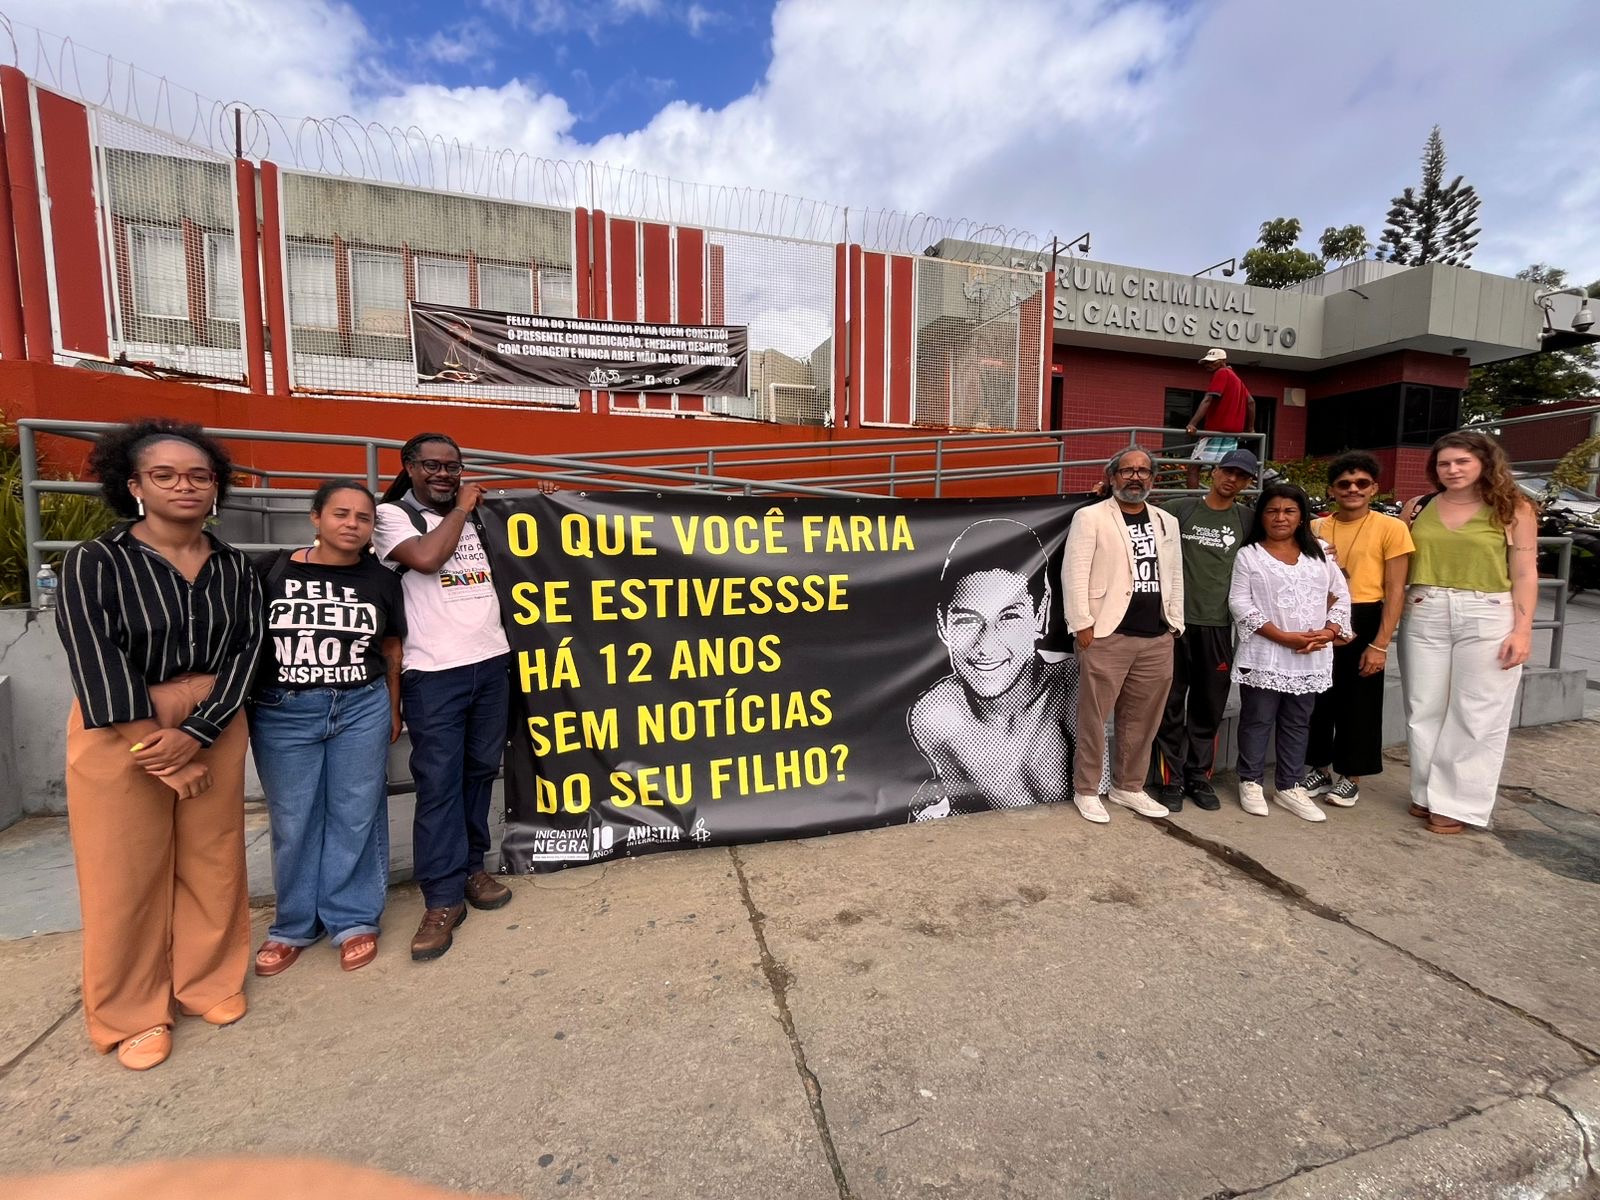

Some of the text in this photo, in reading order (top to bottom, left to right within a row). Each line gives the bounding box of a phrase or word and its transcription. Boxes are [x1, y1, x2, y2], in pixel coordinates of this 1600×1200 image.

[1121, 274, 1256, 315] CRIMINAL
[506, 315, 728, 340] FELIZ DIA DO TRABALHADOR PARA QUEM CONSTRÓI
[1083, 300, 1198, 337] CARLOS
[1209, 318, 1297, 348] SOUTO
[497, 342, 738, 367] COM CORAGEM E NUNCA ABRE MÃO DA SUA DIGNIDADE.
[507, 329, 515, 340] O
[516, 329, 564, 343] PRESENTE
[565, 333, 588, 345] COM
[644, 338, 687, 351] ENFRENTA
[688, 341, 728, 353] DESAFIOS
[506, 506, 915, 559] O QUE VOCÊ FARIA
[1130, 521, 1154, 538] ELE
[285, 579, 358, 602] PELE
[511, 573, 849, 626] SE ESTIVESSSE
[271, 602, 375, 630] PRETA
[273, 629, 372, 666] NÃO É
[277, 665, 368, 684] SUSPEITA!
[518, 633, 782, 694] HÁ 12 ANOS
[526, 687, 833, 757] SEM NOTÍCIAS
[535, 743, 850, 815] DO SEU FILHO?
[535, 825, 613, 851] INICIATIVA 10
[627, 825, 680, 841] ANISTIA
[534, 839, 589, 852] NEGRA
[592, 848, 614, 859] ANOS
